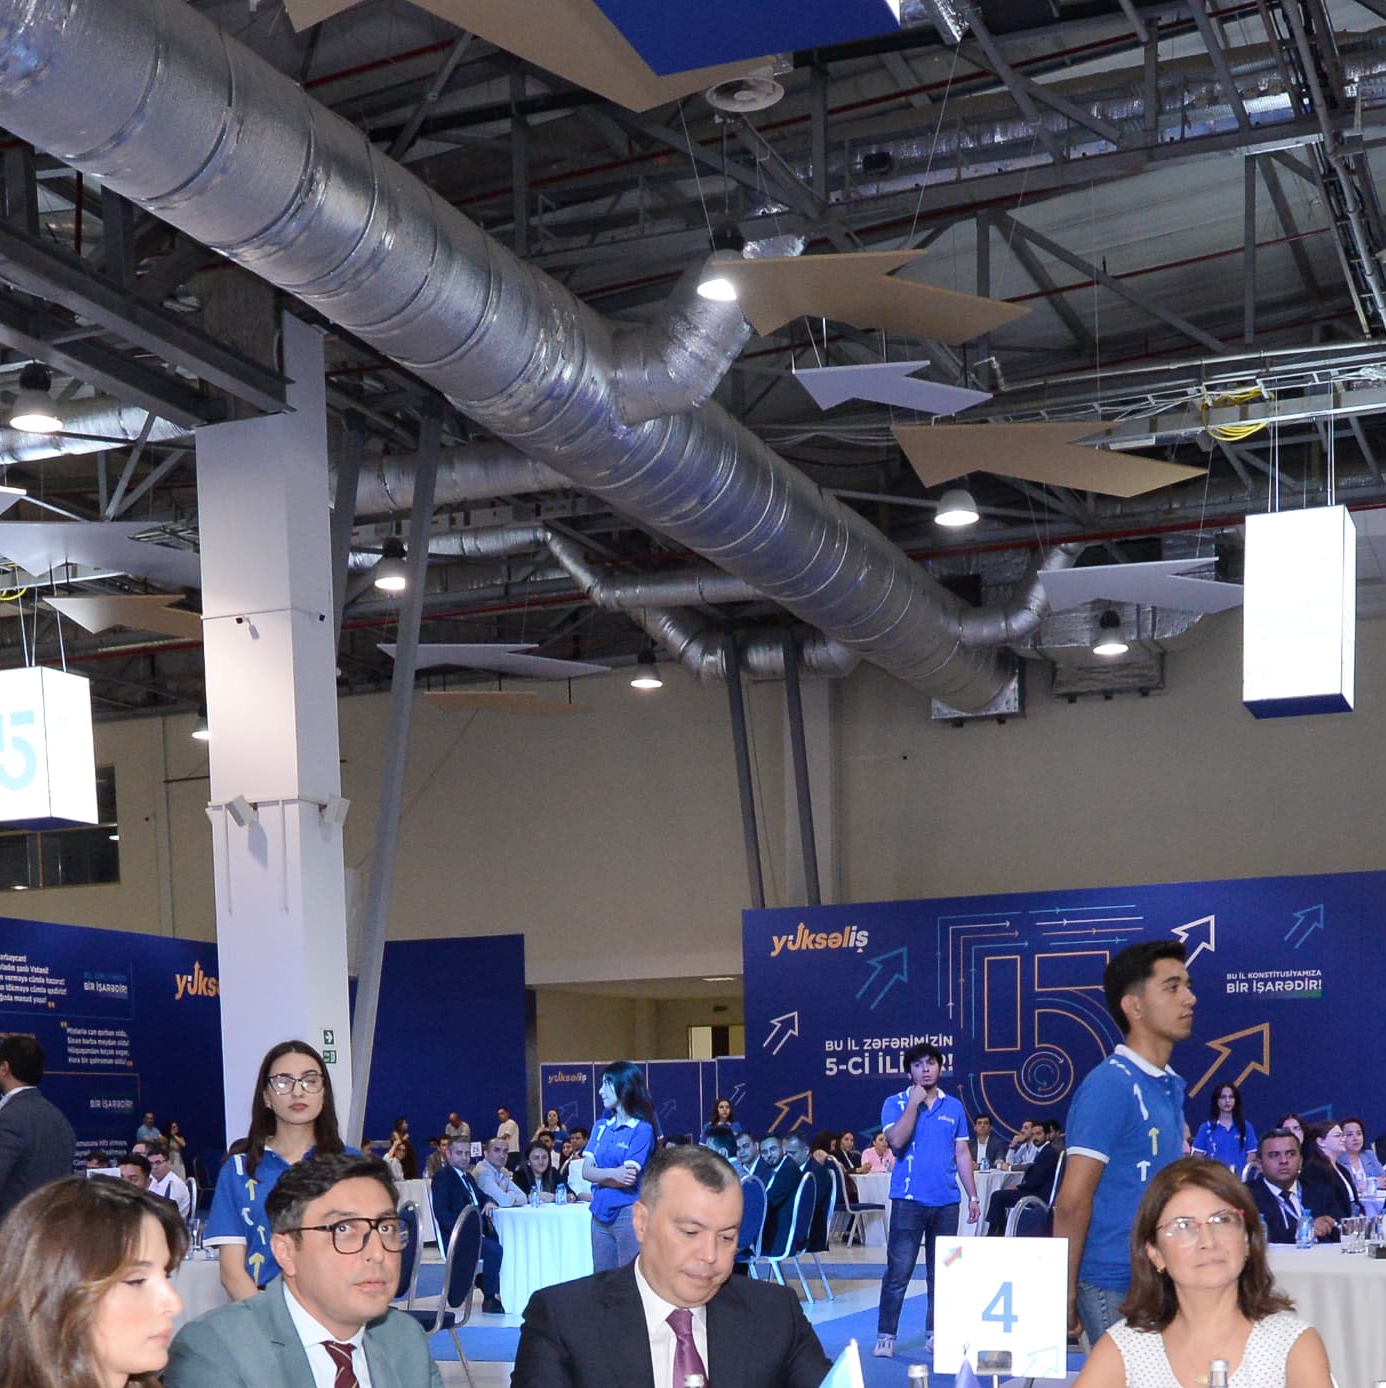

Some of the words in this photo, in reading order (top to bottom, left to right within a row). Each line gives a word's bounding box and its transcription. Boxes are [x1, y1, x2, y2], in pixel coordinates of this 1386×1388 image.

[770, 921, 869, 957] yüksəliş
[175, 960, 220, 1000] yüks
[1227, 980, 1249, 994] BİR
[1253, 977, 1322, 994] İŞARƏDİR!
[1248, 969, 1322, 979] KONSTİTUSİYAMIZA
[825, 1040, 843, 1051] BU
[847, 1036, 859, 1050] İL
[863, 1032, 953, 1050] ZƏFƏRİMİZİN
[825, 1052, 870, 1076] 5-Cİ
[878, 1050, 954, 1074] İLİR!
[981, 1281, 1019, 1334] 4
